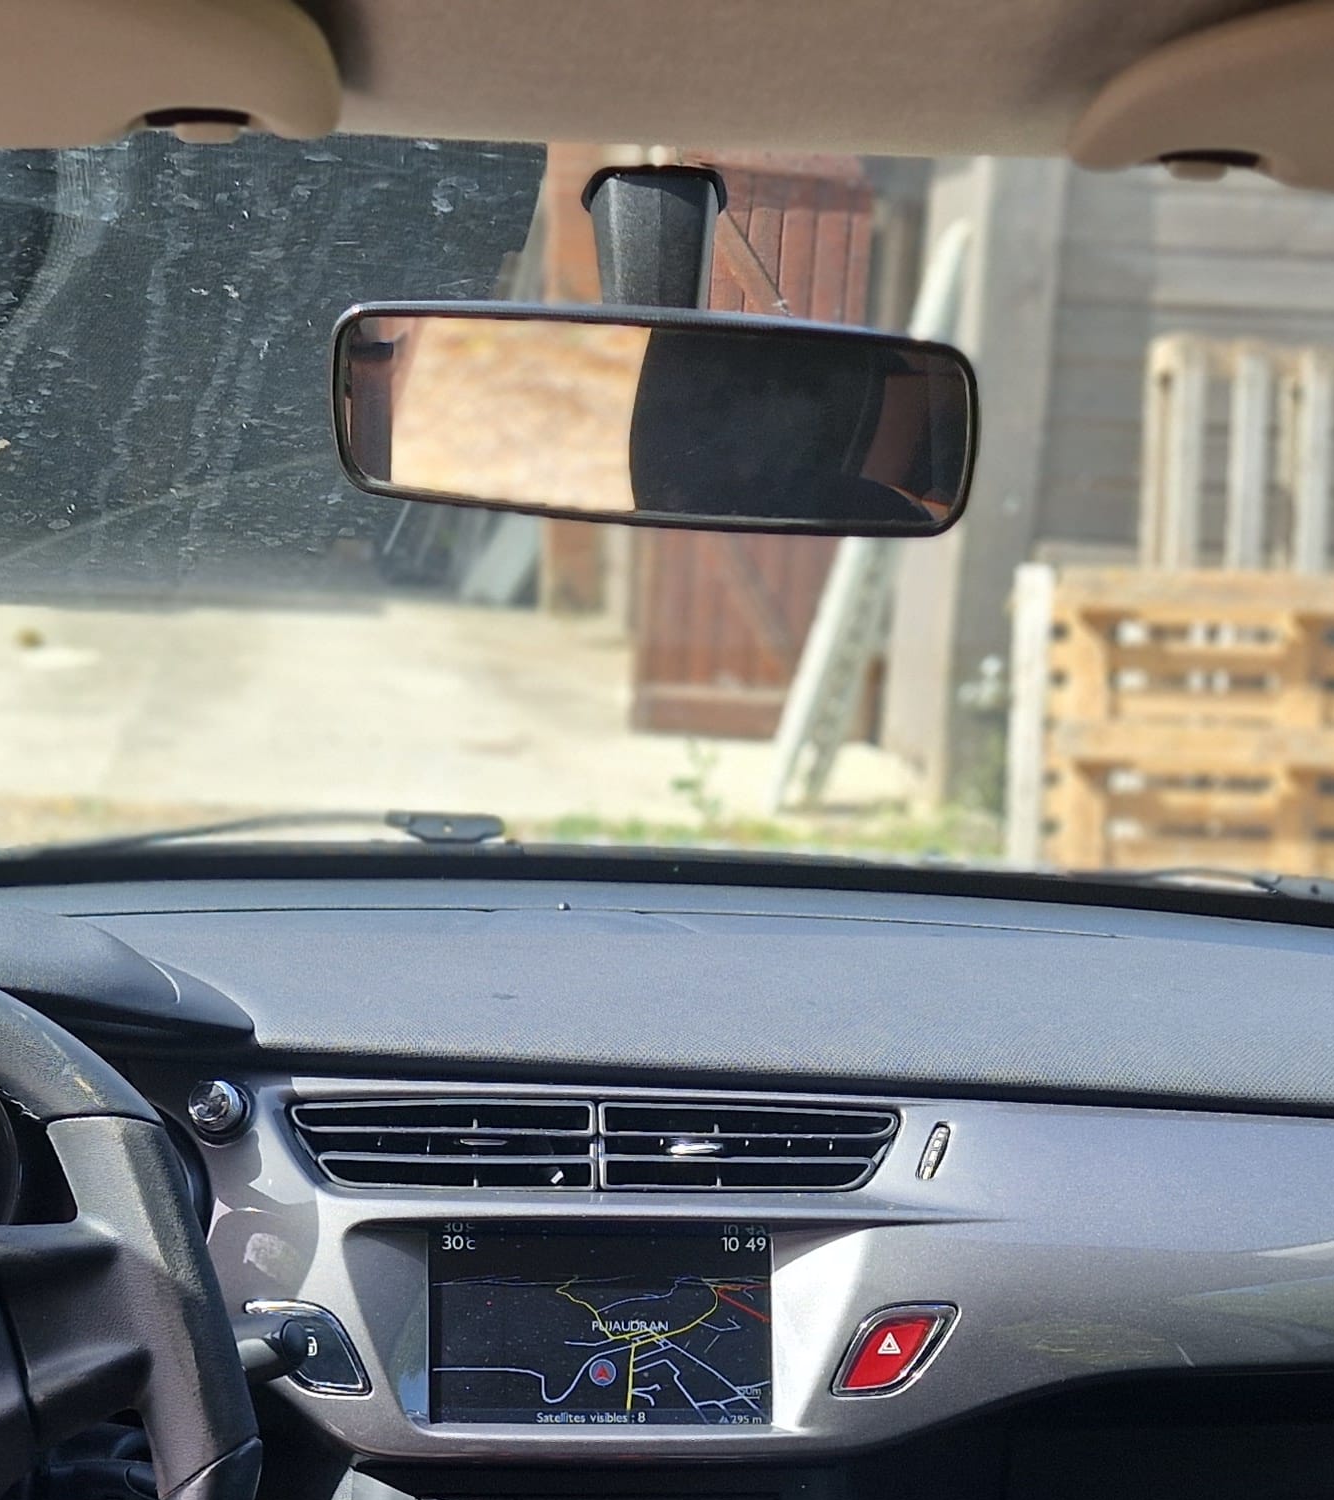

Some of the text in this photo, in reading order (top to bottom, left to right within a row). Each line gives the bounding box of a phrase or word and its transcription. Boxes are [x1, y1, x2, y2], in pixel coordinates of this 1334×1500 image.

[591, 1320, 669, 1332] PUJAUDRAN
[536, 1411, 586, 1423] Satellites
[589, 1411, 628, 1423] visibles
[637, 1412, 646, 1423] 8
[730, 1414, 750, 1424] 295
